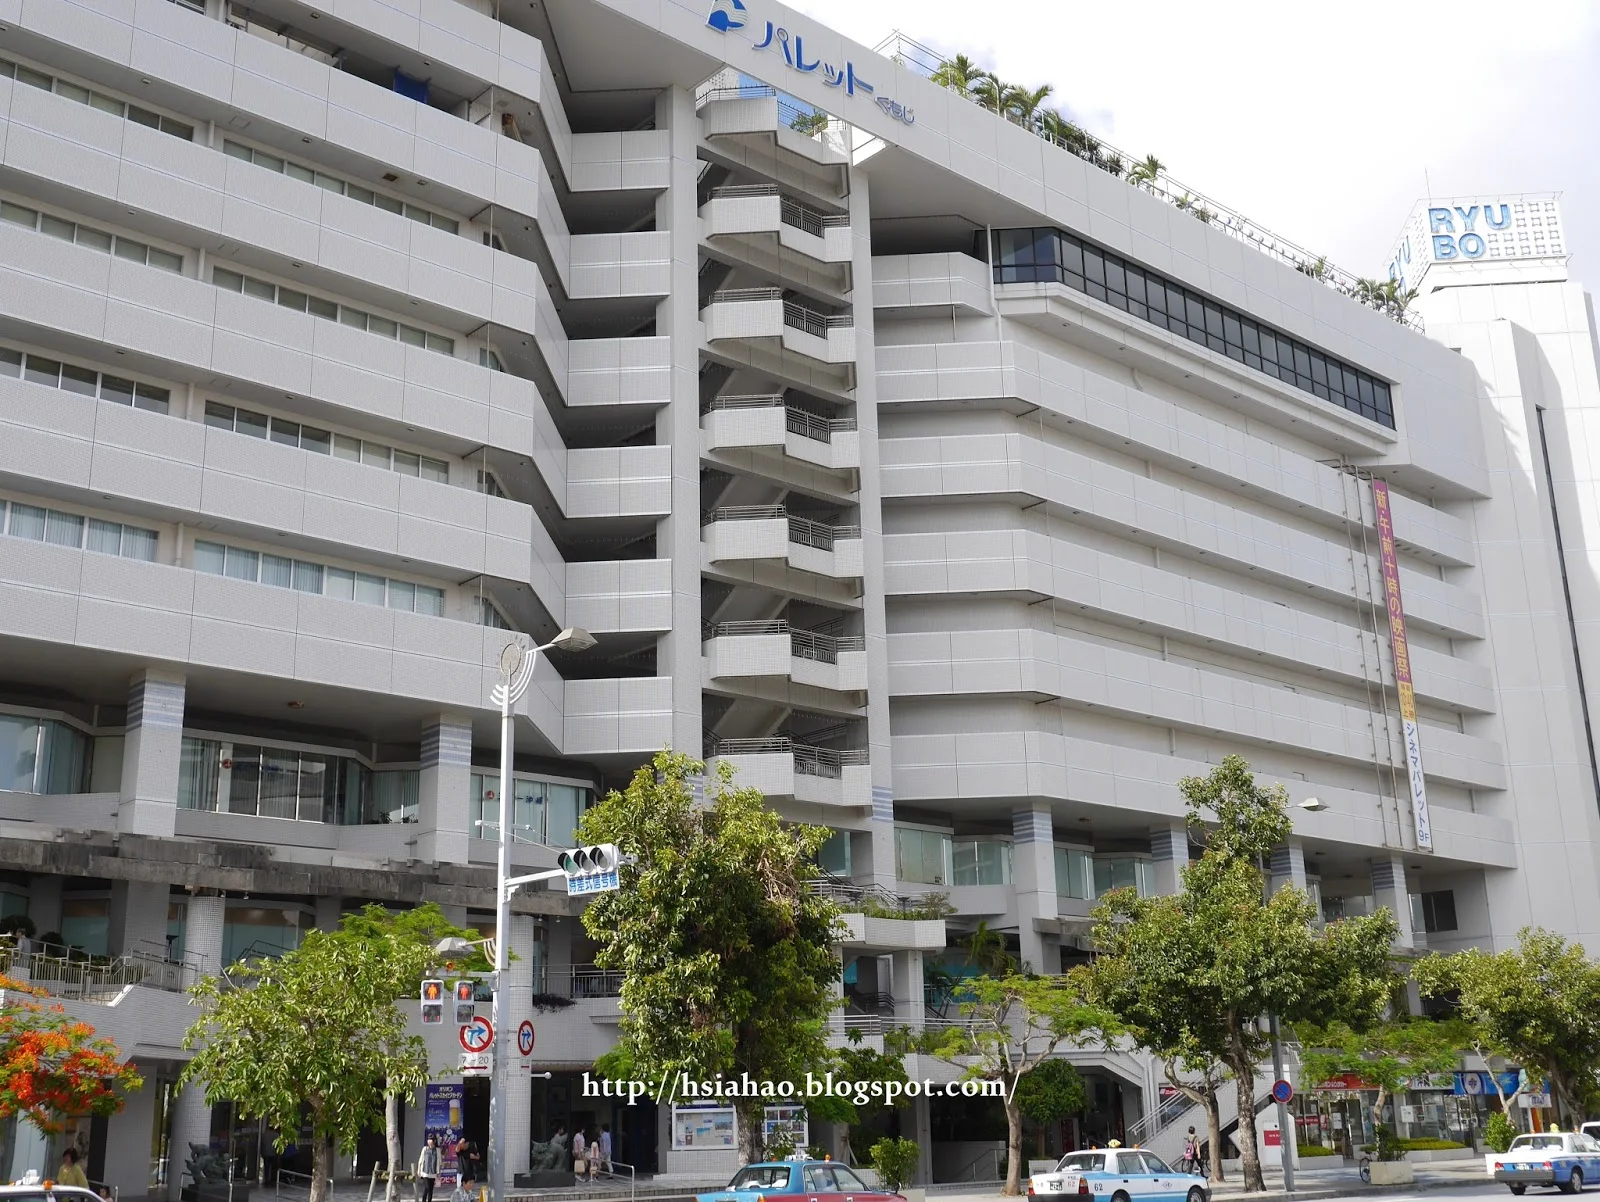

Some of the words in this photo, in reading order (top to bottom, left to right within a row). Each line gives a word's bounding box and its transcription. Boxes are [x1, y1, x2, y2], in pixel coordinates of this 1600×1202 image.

[751, 20, 874, 97] パレット
[1427, 203, 1512, 234] RYU
[1431, 232, 1487, 261] BO
[1094, 1183, 1104, 1192] 62
